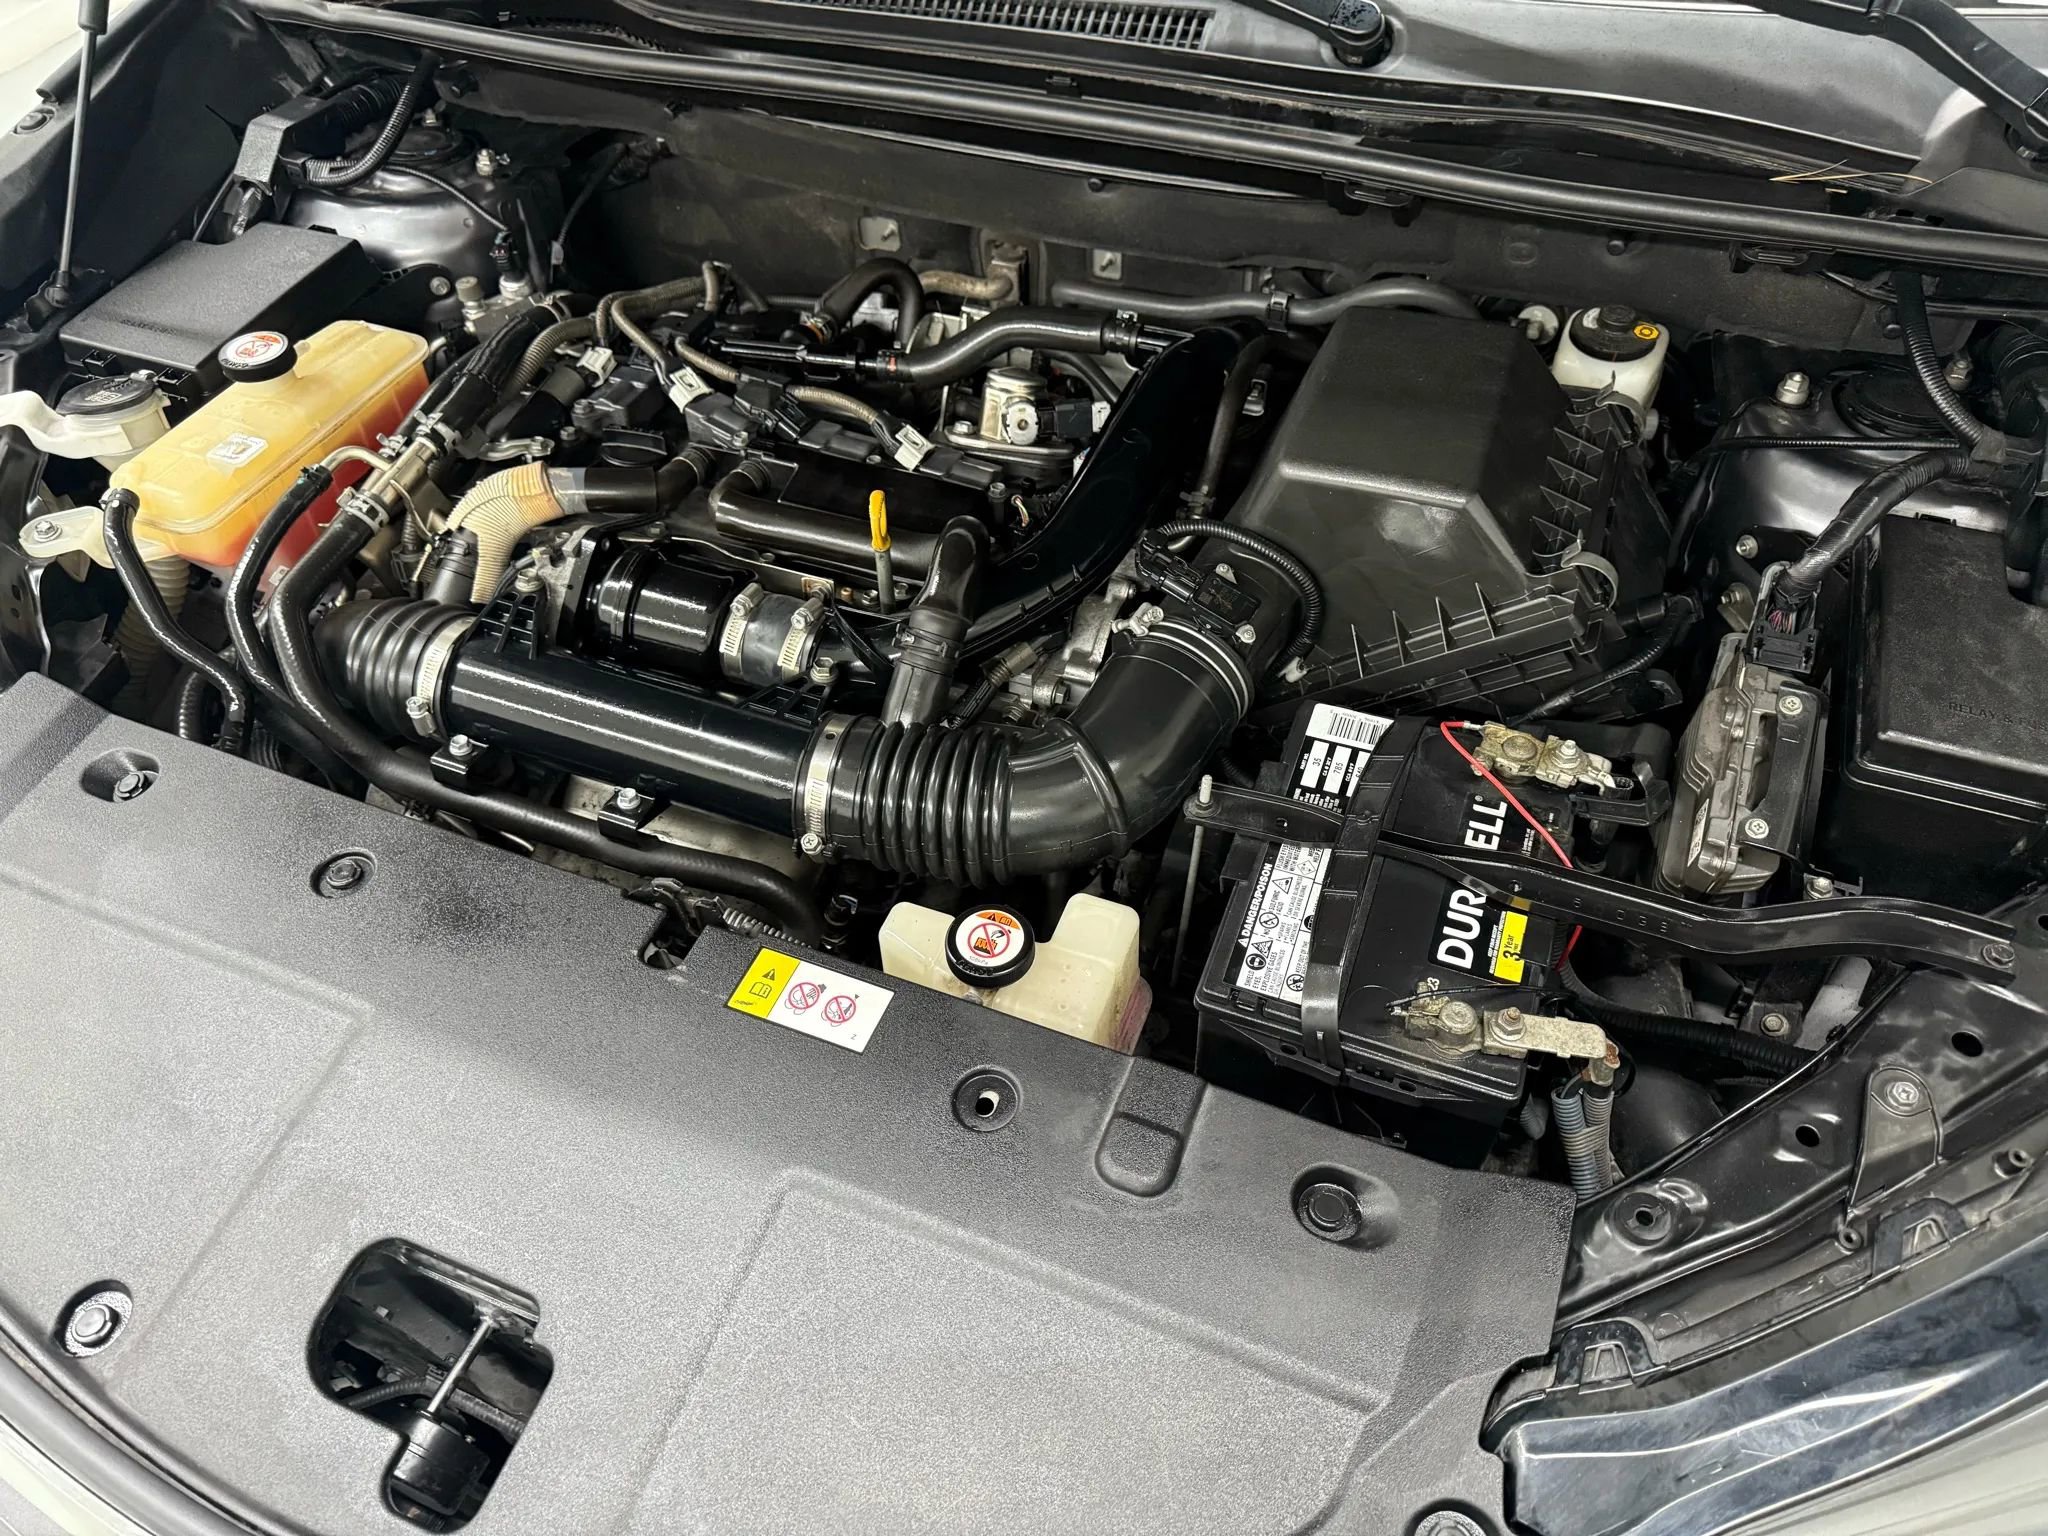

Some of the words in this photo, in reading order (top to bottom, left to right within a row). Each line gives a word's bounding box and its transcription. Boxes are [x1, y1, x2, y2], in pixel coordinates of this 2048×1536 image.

[1949, 702, 1996, 719] RELAY
[1312, 757, 1322, 767] 35
[1333, 761, 1344, 774] 785
[1436, 801, 1507, 969] DURELL
[1241, 862, 1273, 937] DANGER/POISON
[1269, 889, 1280, 910] SULFURIC
[1276, 901, 1284, 912] ACID
[1504, 934, 1515, 949] Year
[1503, 950, 1520, 962] 3
[1245, 970, 1255, 986] SHIELD
[1260, 966, 1273, 991] EXPLOSIVE
[1268, 951, 1278, 966] GASES
